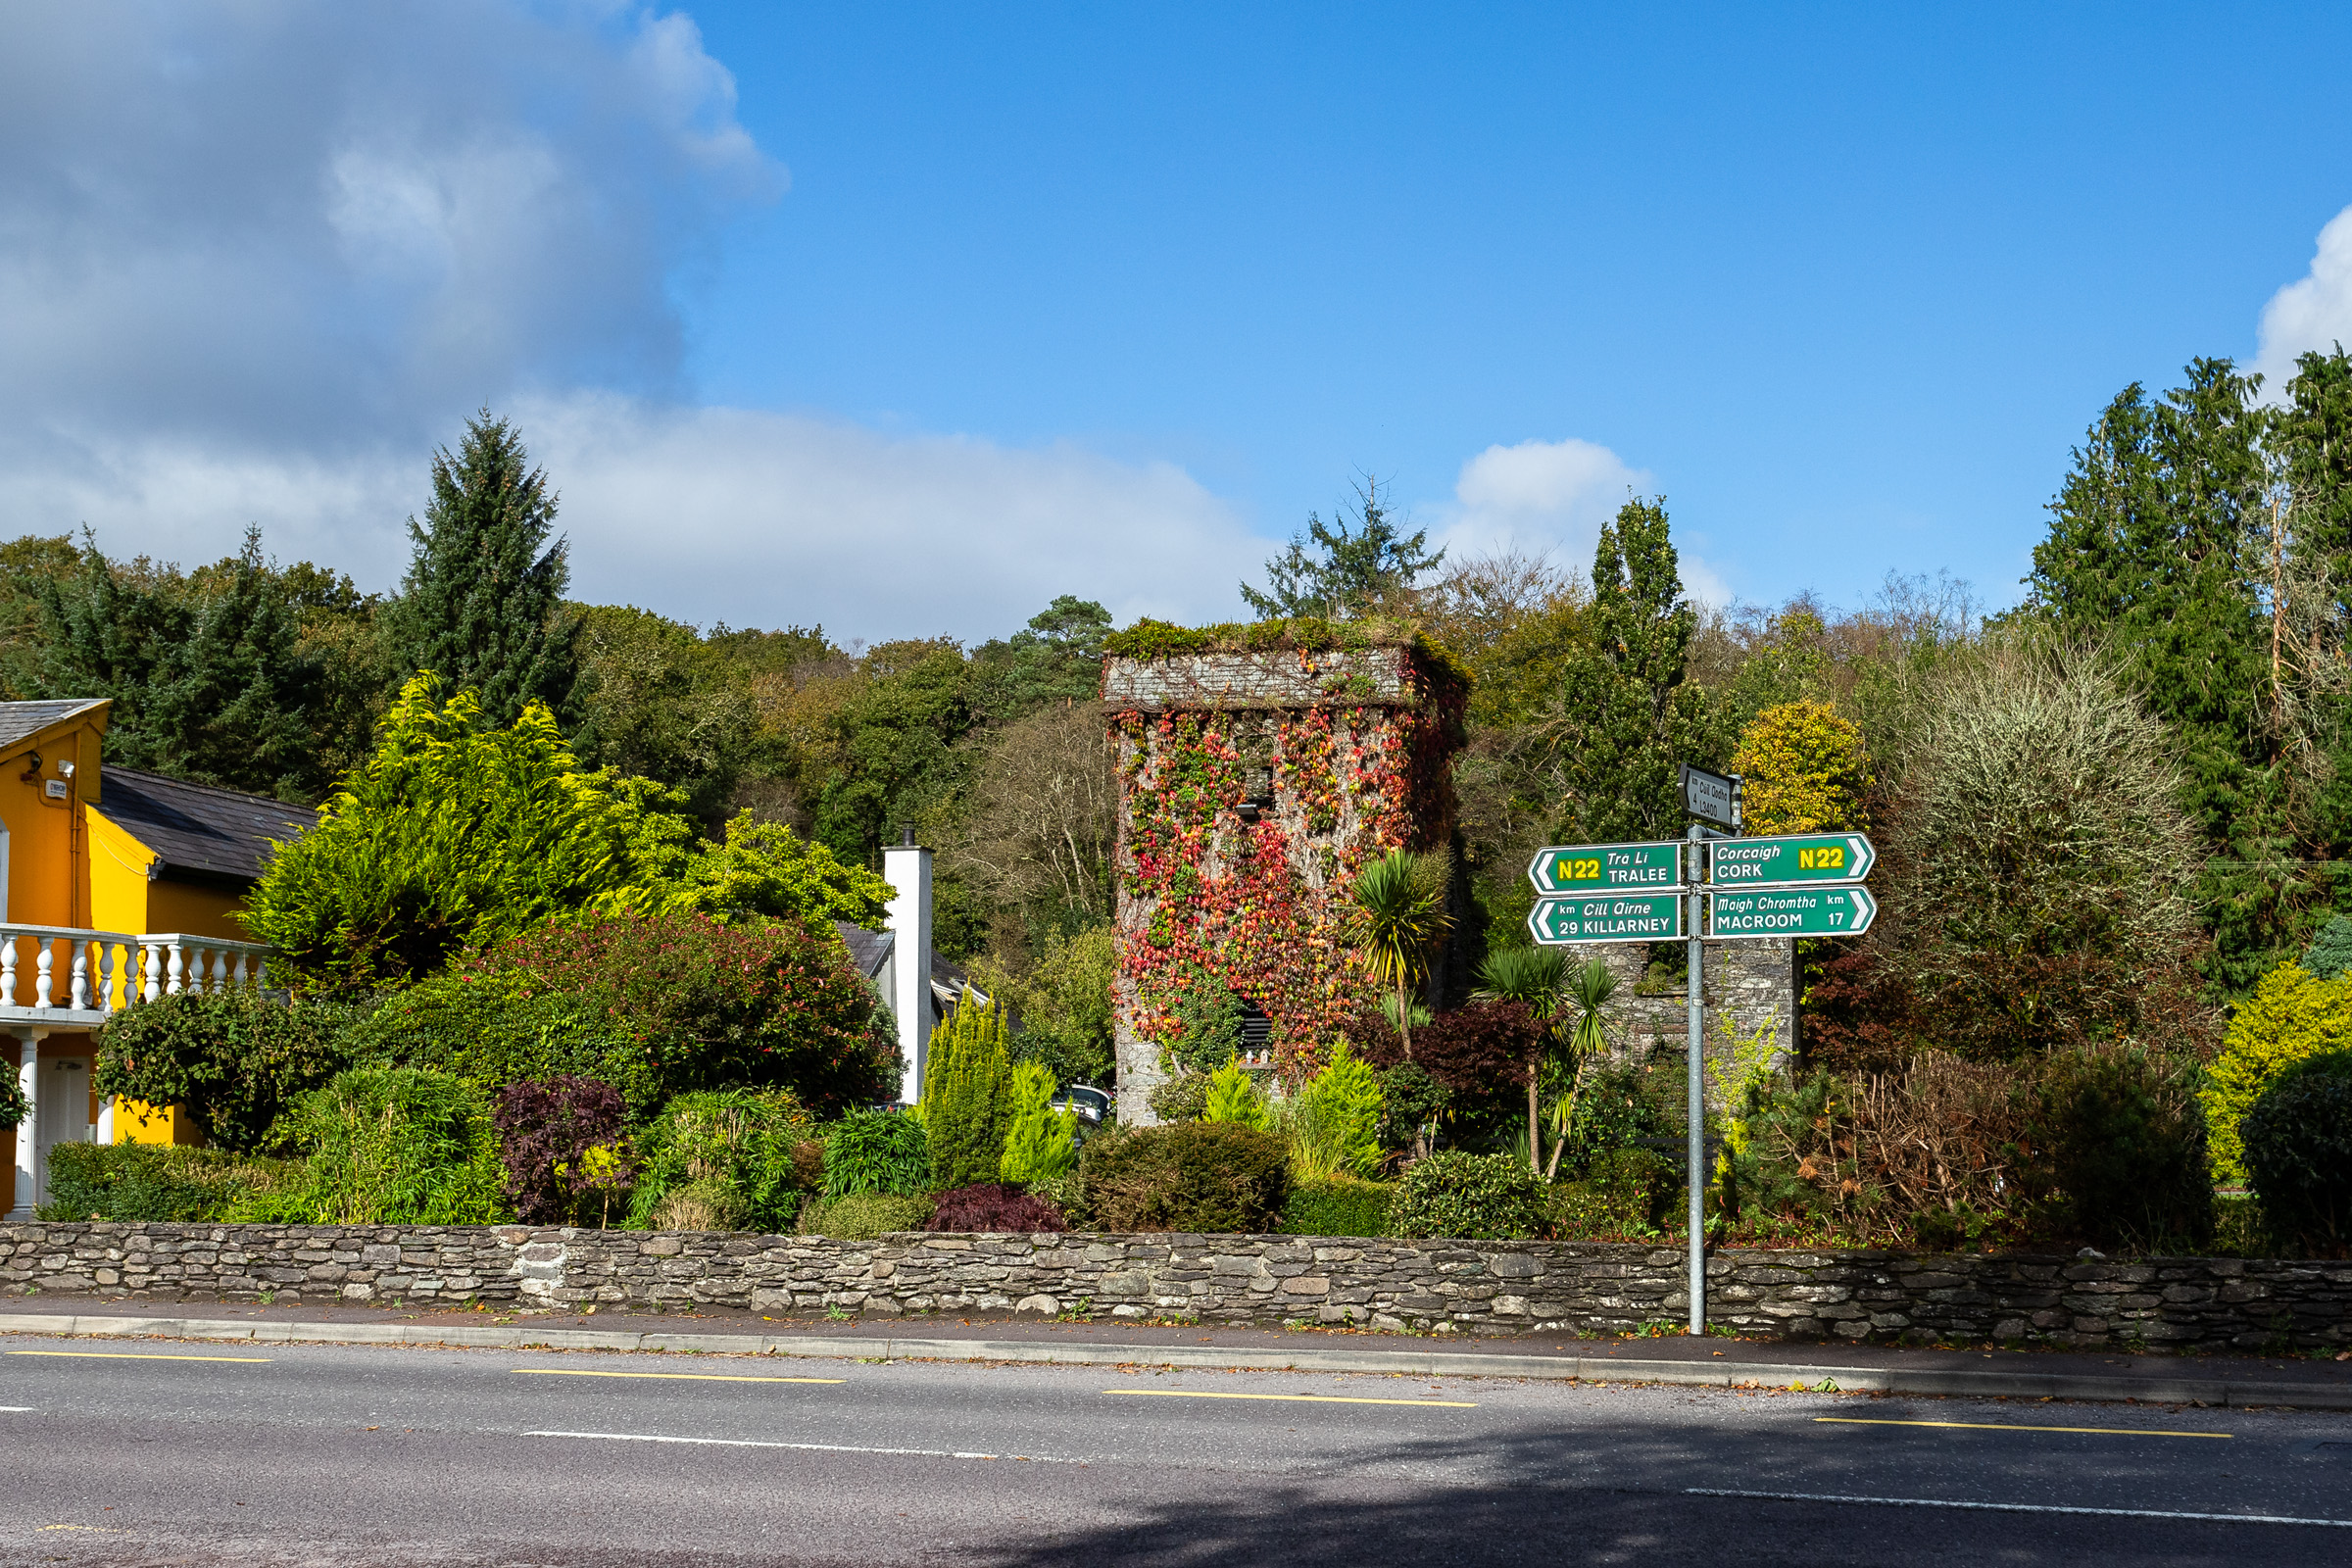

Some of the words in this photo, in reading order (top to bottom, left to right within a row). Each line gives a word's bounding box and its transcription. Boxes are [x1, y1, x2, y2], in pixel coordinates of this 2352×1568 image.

[1692, 793, 1697, 806] 4
[1699, 800, 1718, 818] L3400
[1607, 853, 1630, 865] Trá
[1635, 852, 1648, 864] Lí
[1717, 845, 1781, 860] Corcaigh
[1800, 848, 1843, 868] N22
[1559, 859, 1599, 879] N22
[1608, 868, 1667, 883] TRALEE
[1717, 863, 1763, 878] CORK
[1717, 898, 1753, 912] Maigh
[1758, 896, 1817, 910] Chromtha
[1827, 895, 1844, 905] km
[1559, 905, 1576, 914] km
[1584, 903, 1607, 916] Cill
[1717, 913, 1802, 929] MACROOM
[1829, 912, 1843, 925] 17
[1559, 922, 1578, 935] 29
[1584, 918, 1670, 934] KILLARNEY
